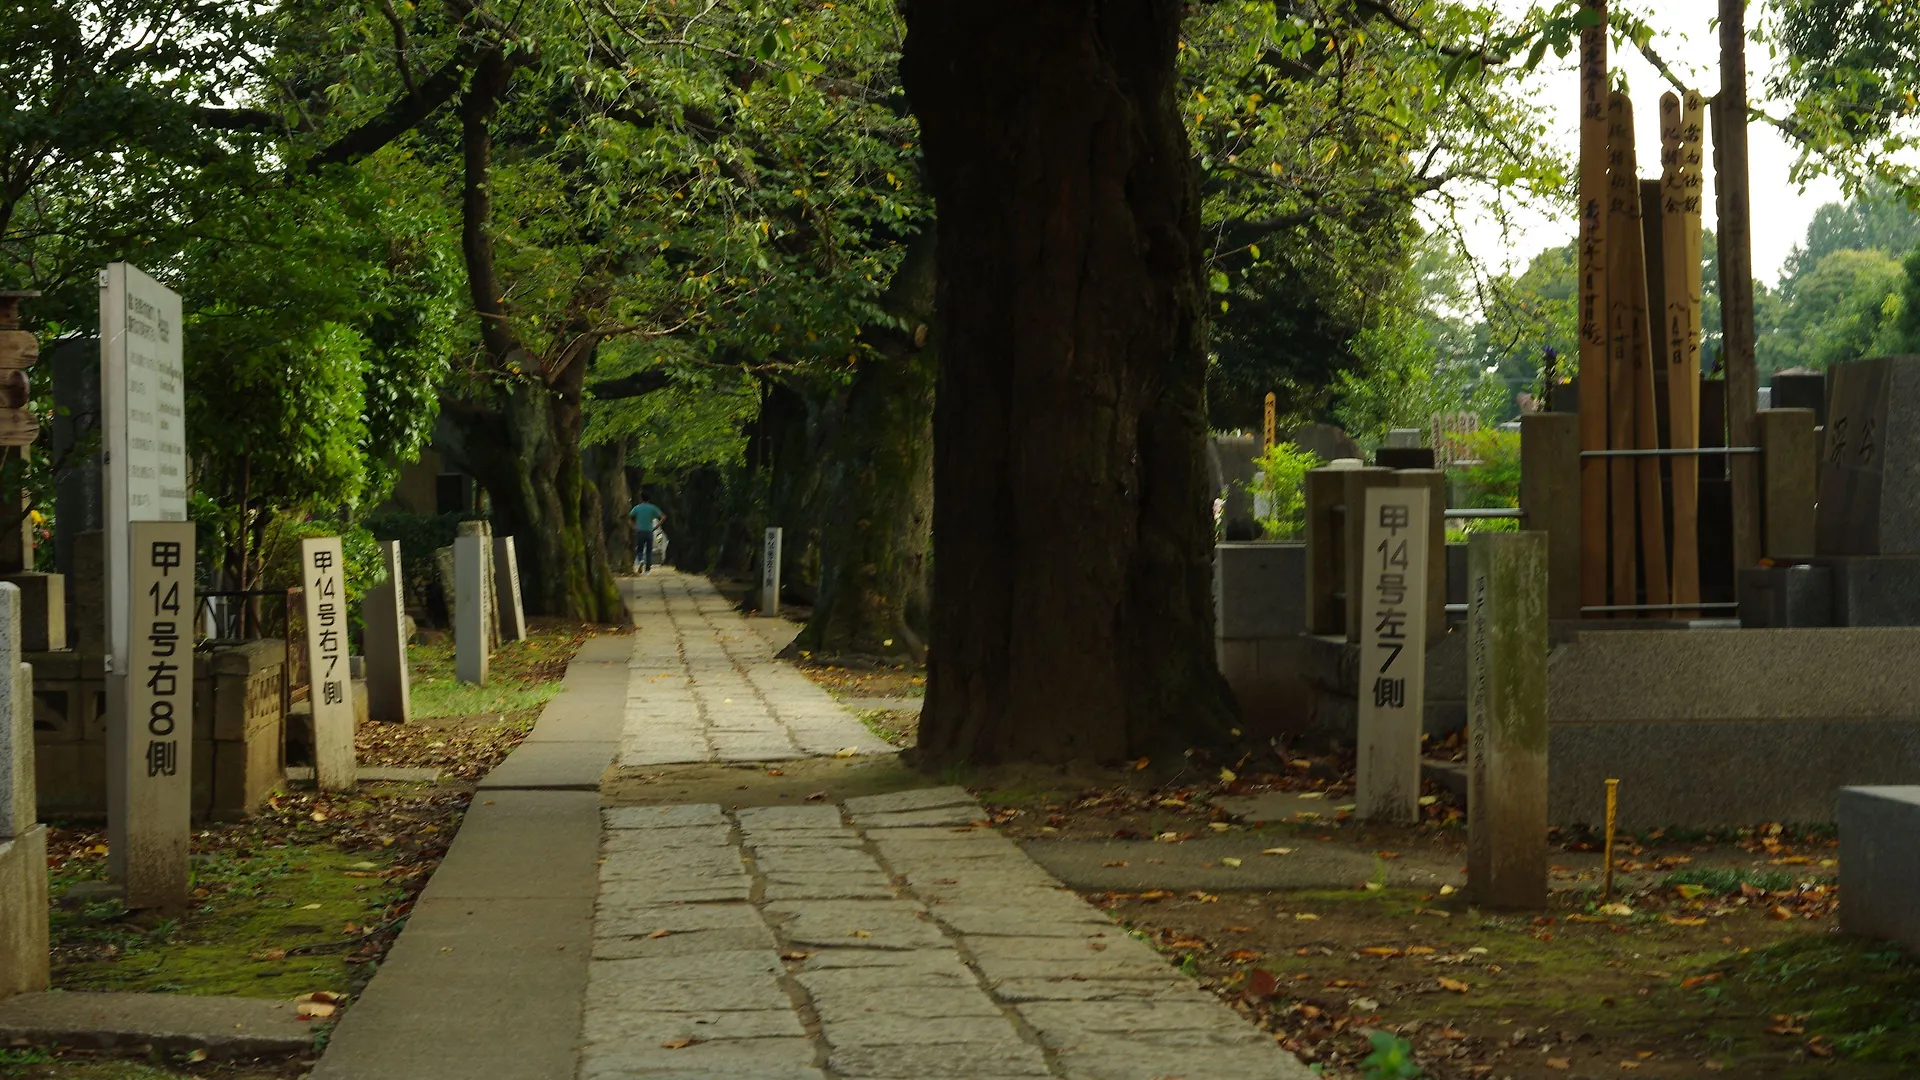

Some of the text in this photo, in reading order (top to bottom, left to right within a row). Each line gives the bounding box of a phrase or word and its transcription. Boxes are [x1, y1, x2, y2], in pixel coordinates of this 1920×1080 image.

[146, 541, 181, 778] 甲14号右8側
[313, 551, 345, 706] 甲14号右7側
[1372, 504, 1409, 709] 甲14号左7側
